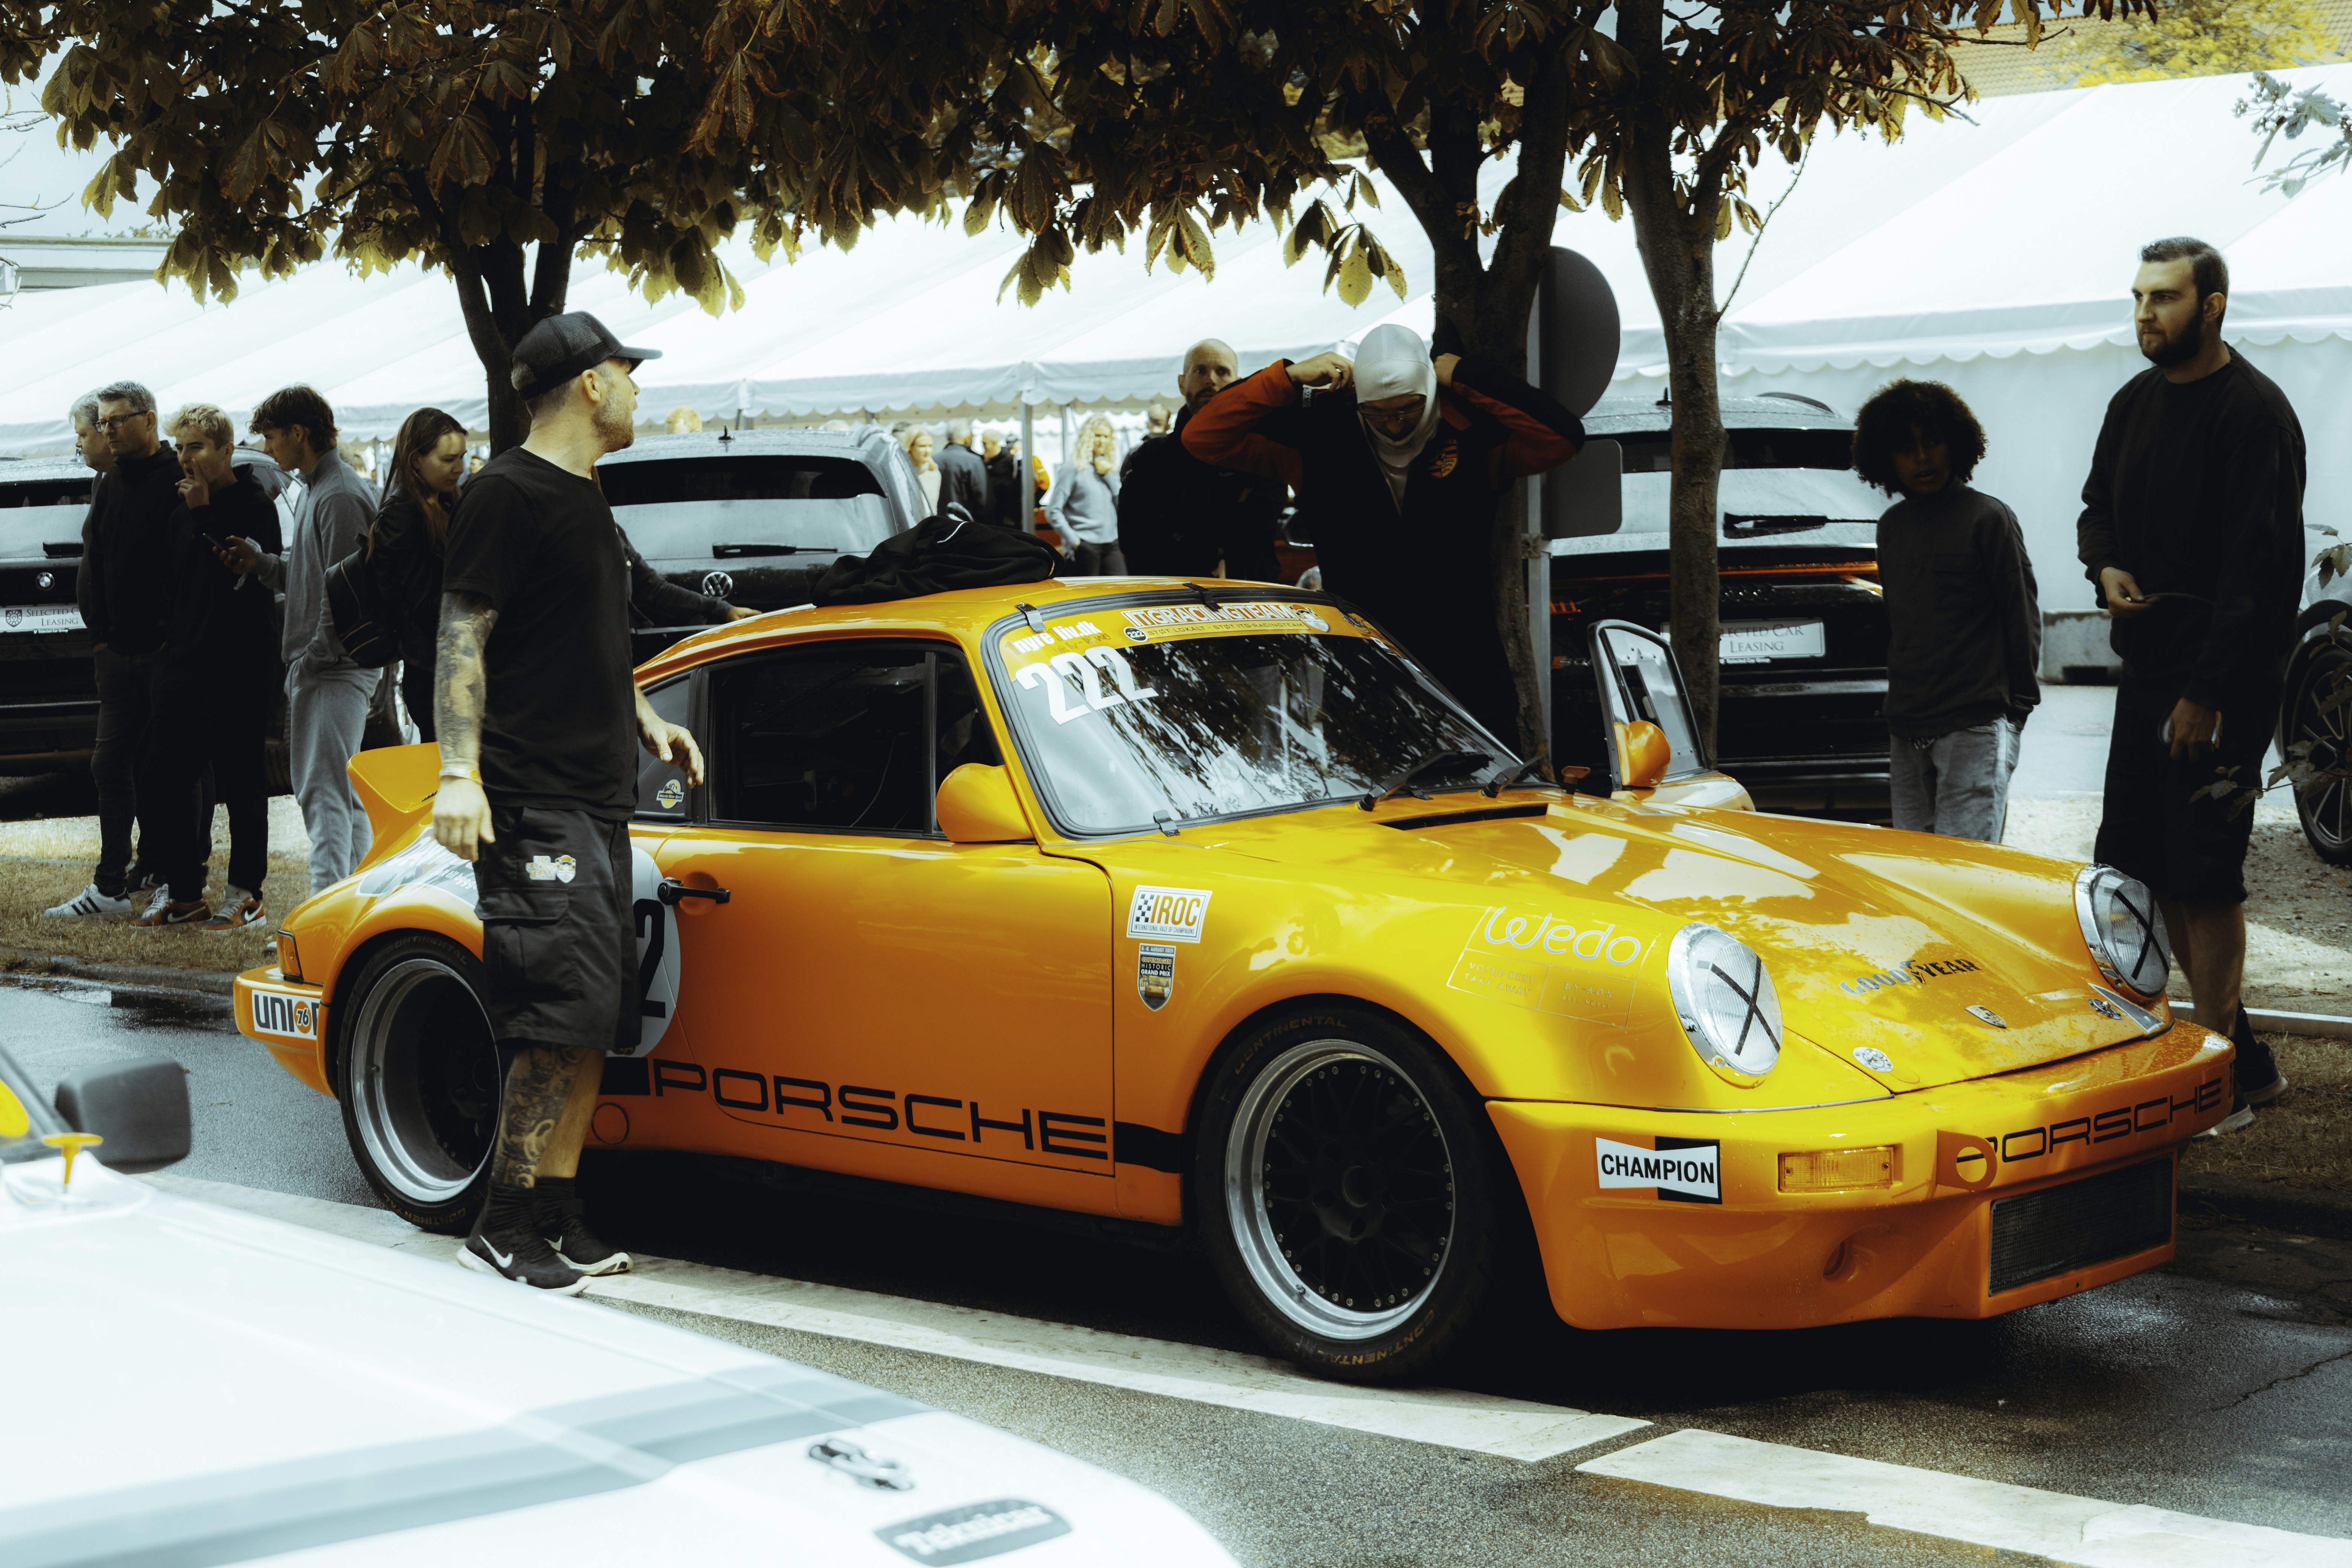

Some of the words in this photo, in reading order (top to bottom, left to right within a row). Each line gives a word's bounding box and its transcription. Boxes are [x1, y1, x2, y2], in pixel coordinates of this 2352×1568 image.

[41, 618, 78, 626] LEASING
[1720, 626, 1769, 637] LECTED
[1127, 630, 1145, 638] 222
[1730, 640, 1784, 652] LEASING
[1015, 646, 1159, 725] 222
[1150, 895, 1201, 926] IROC
[1484, 906, 1641, 965] Wedo
[1141, 956, 1172, 965] COPENHAGEN
[1469, 962, 1504, 977] VOTED
[1508, 971, 1534, 983] BEST
[1465, 973, 1492, 987] TAKE
[1497, 982, 1531, 996] AWAY
[1564, 982, 1579, 992] BY
[297, 1009, 310, 1026] 76
[1235, 1016, 1347, 1075] CONTINENTAL
[653, 1058, 1109, 1160] PORSCHE
[1601, 1153, 1716, 1184] CHAMPION
[1317, 1309, 1435, 1365] CONTINENTAL
